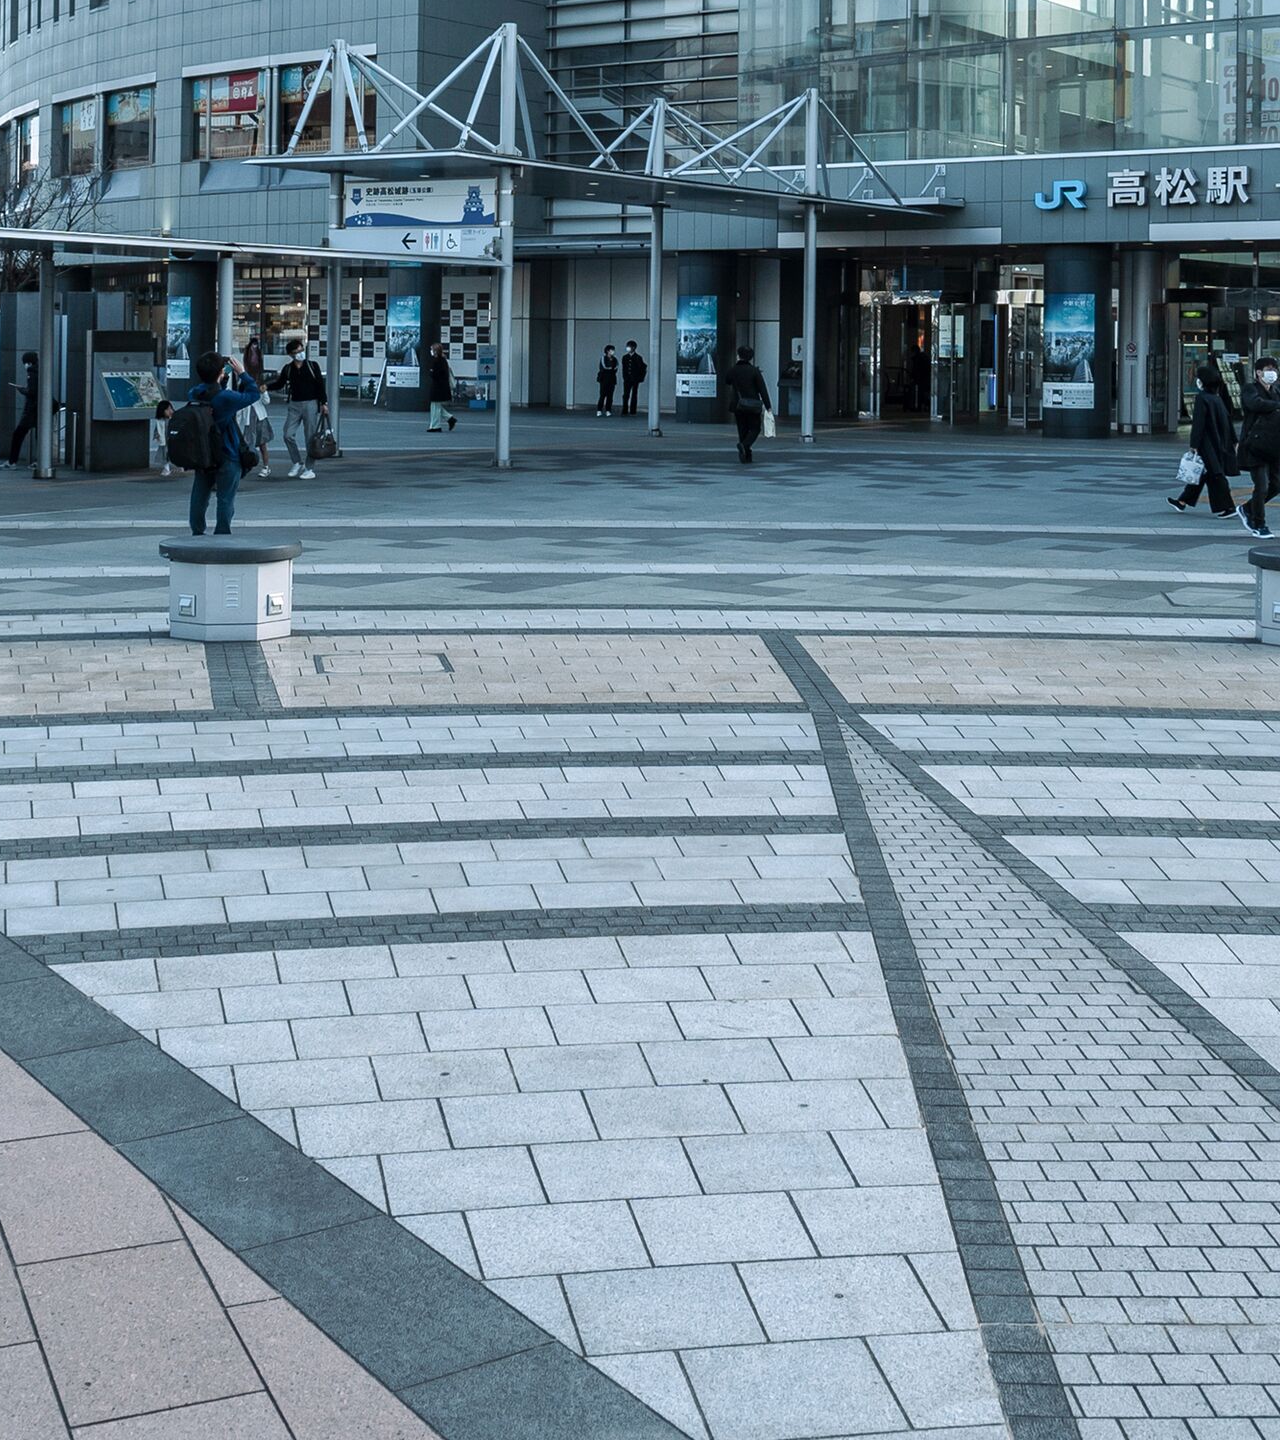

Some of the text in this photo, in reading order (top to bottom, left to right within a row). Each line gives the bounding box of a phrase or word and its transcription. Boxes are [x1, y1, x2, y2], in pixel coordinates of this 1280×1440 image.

[1034, 179, 1087, 210] JR
[1107, 166, 1251, 208] 高松駅
